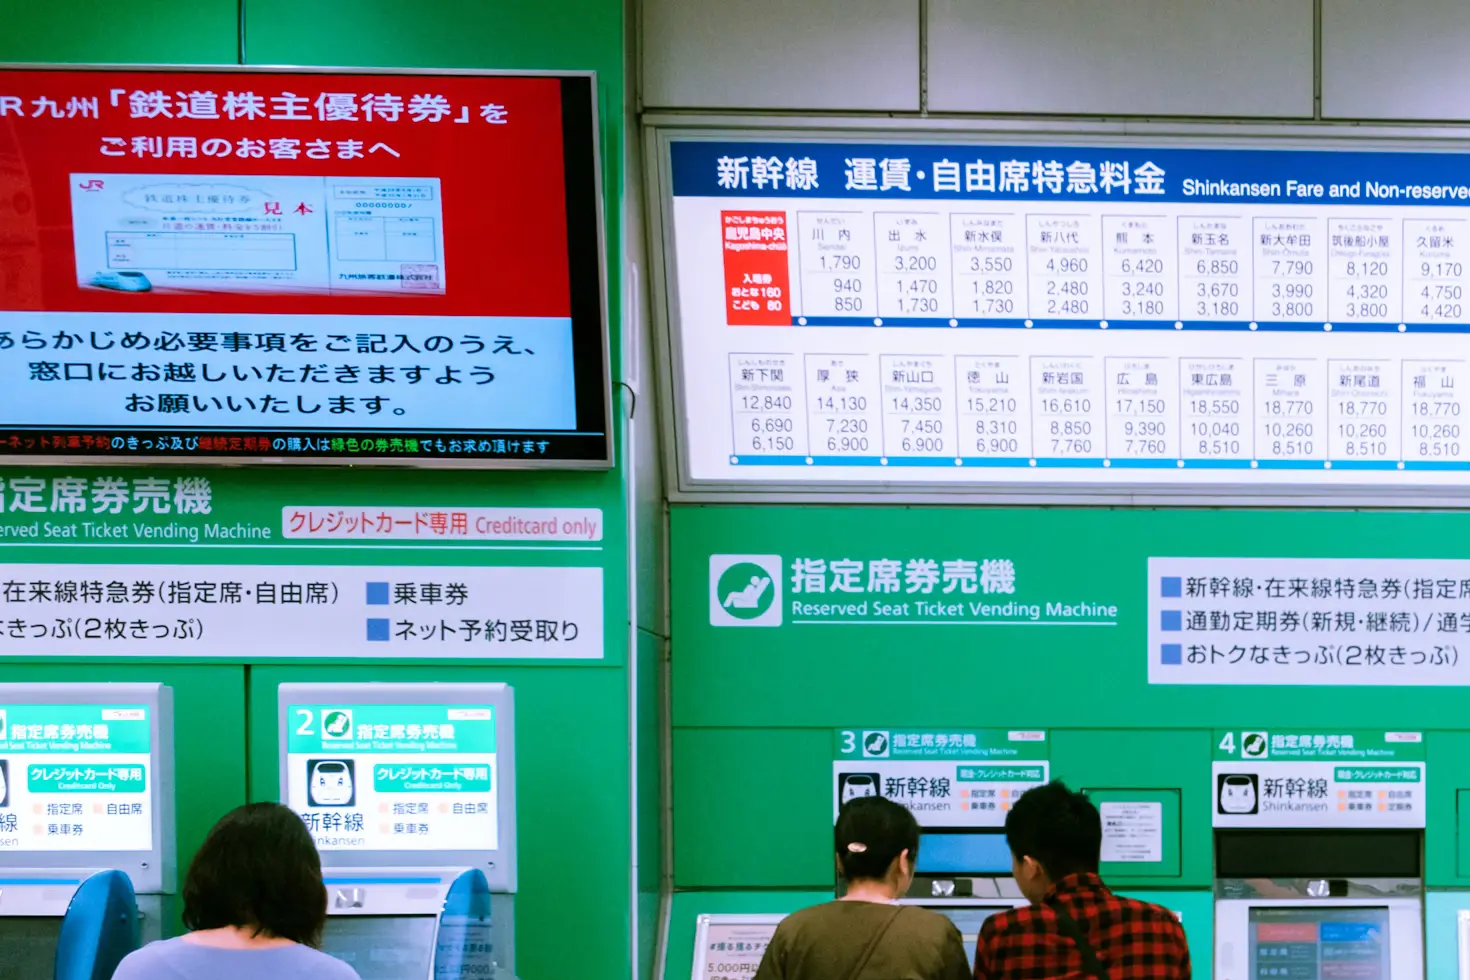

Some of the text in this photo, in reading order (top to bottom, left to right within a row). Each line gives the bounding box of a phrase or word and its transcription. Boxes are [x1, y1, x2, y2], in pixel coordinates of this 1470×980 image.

[99, 136, 401, 160] ご利用のお客さまへ
[717, 156, 1166, 196] 新幹線 運賃・自由席特急料金
[1183, 178, 1281, 198] Shinkansen
[1286, 180, 1324, 197] Fare
[1328, 181, 1361, 199] and
[819, 255, 861, 272] 1,790
[894, 256, 937, 272] 3,200
[1046, 258, 1089, 274] 4,960
[1196, 259, 1239, 275] 6,850
[1346, 261, 1389, 278] 8,120
[29, 361, 496, 385] 窓口にお越しいただきますよう
[125, 392, 406, 416] お願いいたします。
[741, 395, 792, 411] 12,840
[891, 396, 943, 413] 14,350
[1041, 398, 1091, 414] 16,610
[1190, 399, 1240, 416] 18,550
[1264, 400, 1314, 417] 18,770
[0, 475, 213, 515] 定席券売機
[43, 522, 78, 538] Seat
[82, 522, 129, 539] Ticket
[133, 522, 199, 543] Vending
[204, 522, 272, 539] Machine
[288, 510, 597, 540] クレジットカード専用 Creditcard only
[790, 558, 1017, 595] 指定席券売機
[393, 583, 469, 606] 乗車券
[792, 600, 1118, 622] Reserved Seat Ticket Vending Machine
[394, 619, 580, 642] ネット予約受取り
[295, 709, 315, 736] 2
[840, 731, 856, 753] 3
[1218, 731, 1236, 754] 4
[884, 776, 951, 799] 新幹線
[1263, 777, 1329, 799] 新幹線
[106, 803, 143, 816] 自由席
[1262, 802, 1329, 812] Shinkansen
